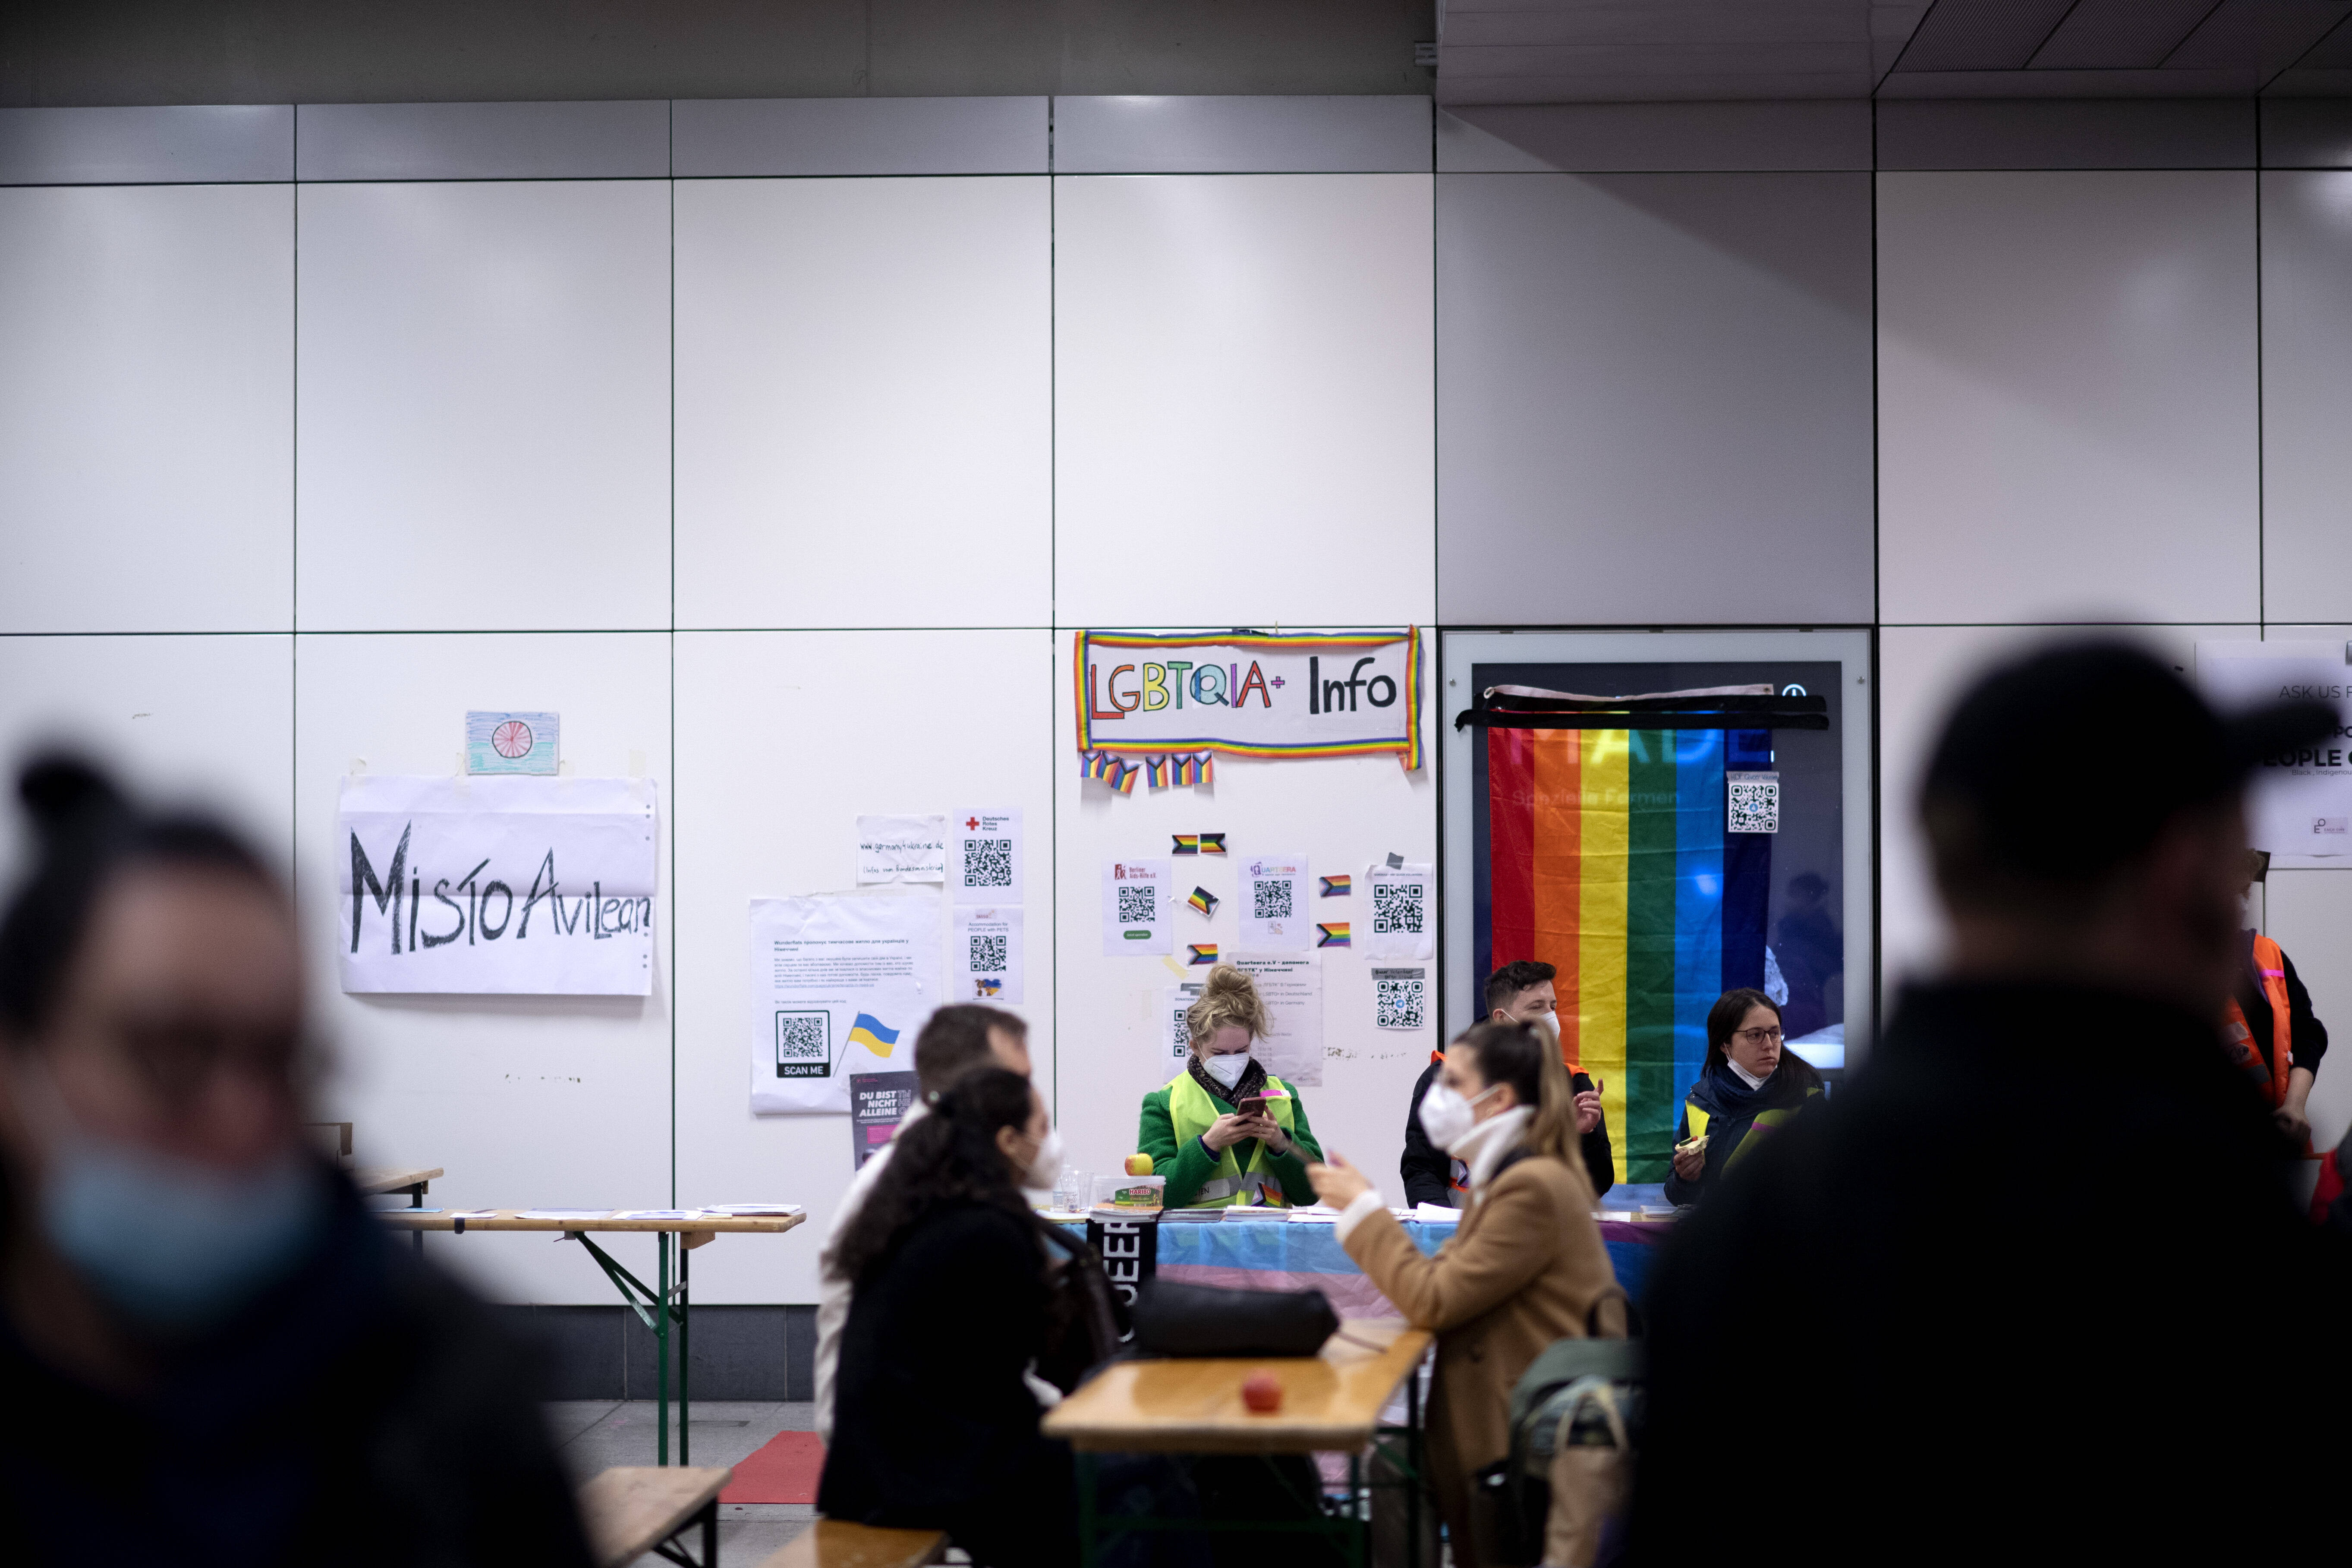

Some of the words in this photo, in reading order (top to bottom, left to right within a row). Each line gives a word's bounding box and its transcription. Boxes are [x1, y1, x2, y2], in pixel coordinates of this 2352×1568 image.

[1091, 660, 1285, 720] LGBTQIA+
[1310, 656, 1397, 715] Info
[2279, 685, 2313, 699] ASK
[2318, 685, 2340, 699] US
[784, 1066, 808, 1075] SCAN
[810, 1066, 824, 1074] ME
[859, 1092, 874, 1100] DU
[875, 1090, 897, 1099] BIST
[867, 1099, 897, 1108] NICHT
[859, 1107, 897, 1117] ALLEINE
